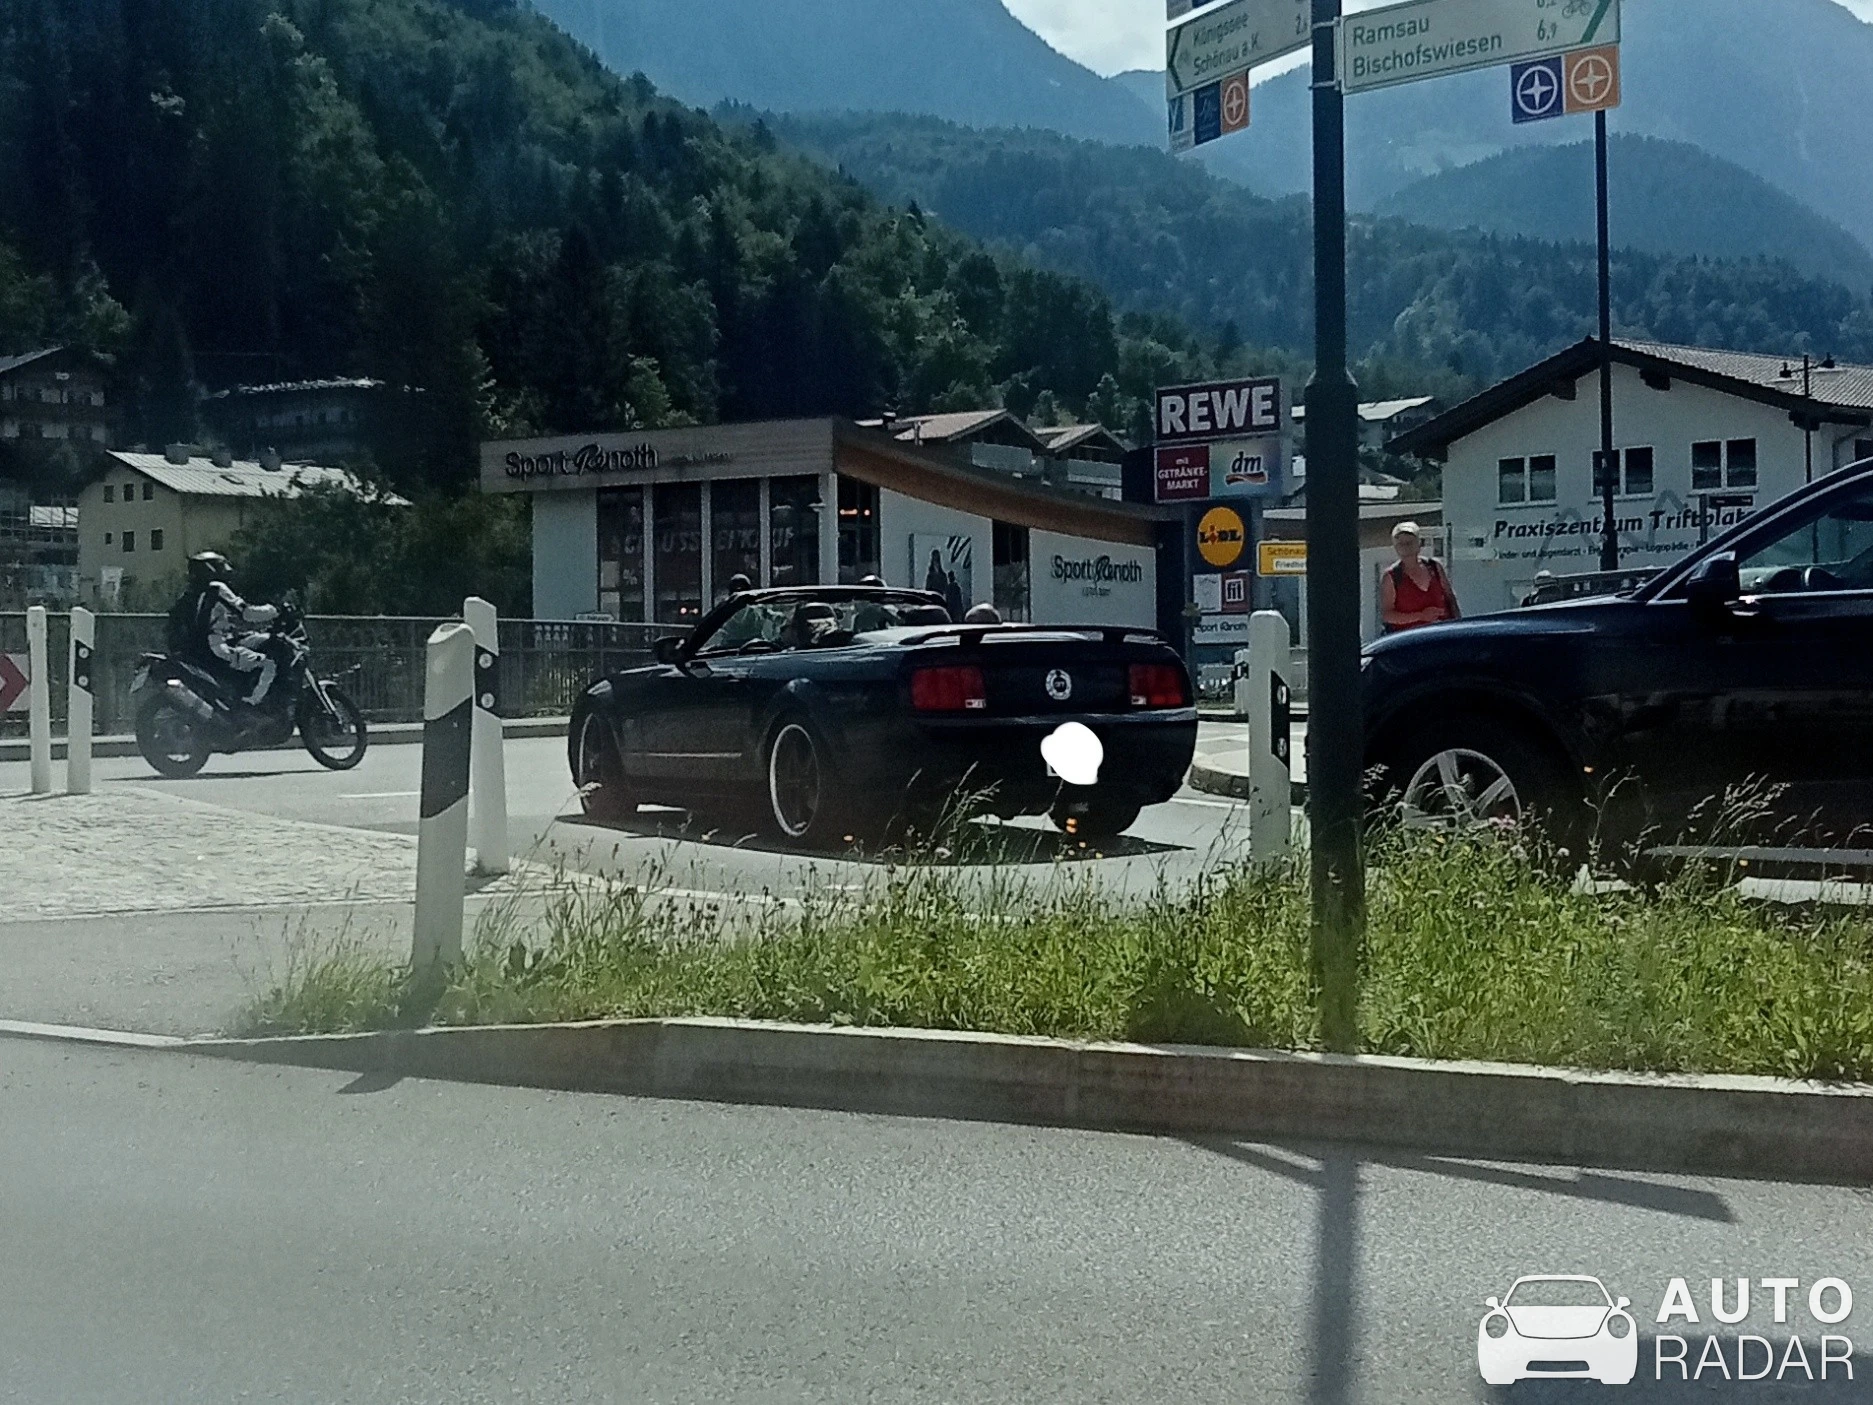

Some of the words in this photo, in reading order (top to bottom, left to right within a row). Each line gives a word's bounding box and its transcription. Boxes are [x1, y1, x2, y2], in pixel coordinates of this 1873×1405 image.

[1352, 17, 1430, 46] Ramsau
[1353, 33, 1503, 78] Bischofswiesen
[1536, 18, 1558, 42] 6,9
[1159, 384, 1276, 435] REWE
[505, 450, 571, 482] Sport
[1231, 450, 1263, 474] dm
[1166, 478, 1199, 490] MARKT
[1494, 514, 1643, 539] Praxiszentum
[1052, 554, 1091, 584] Sport
[1275, 560, 1305, 570] Friedho
